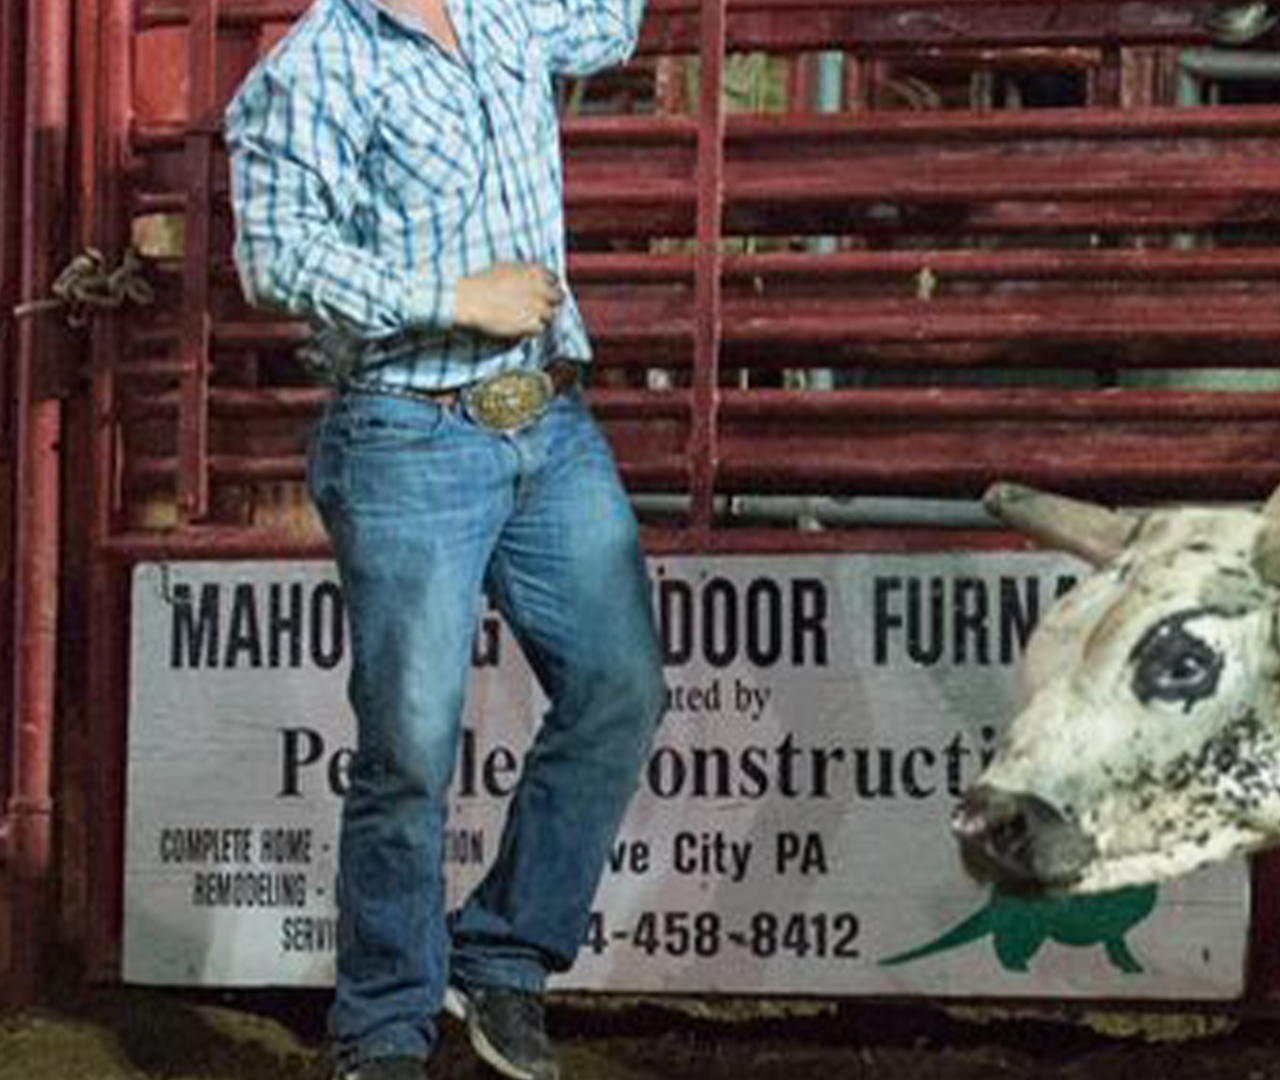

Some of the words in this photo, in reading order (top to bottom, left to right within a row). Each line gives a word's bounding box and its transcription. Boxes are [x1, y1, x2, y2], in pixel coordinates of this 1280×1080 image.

[661, 577, 828, 668] DOOR
[874, 575, 1076, 666] FURN
[735, 680, 770, 719] by
[648, 726, 996, 798] onstructi
[161, 829, 252, 863] COMPLETE
[261, 829, 312, 863] HOME
[674, 832, 752, 882] City
[777, 832, 828, 875] PA
[194, 873, 306, 907] REMODELING
[281, 918, 336, 952] SERVI
[583, 912, 860, 958] 4-458-8412
